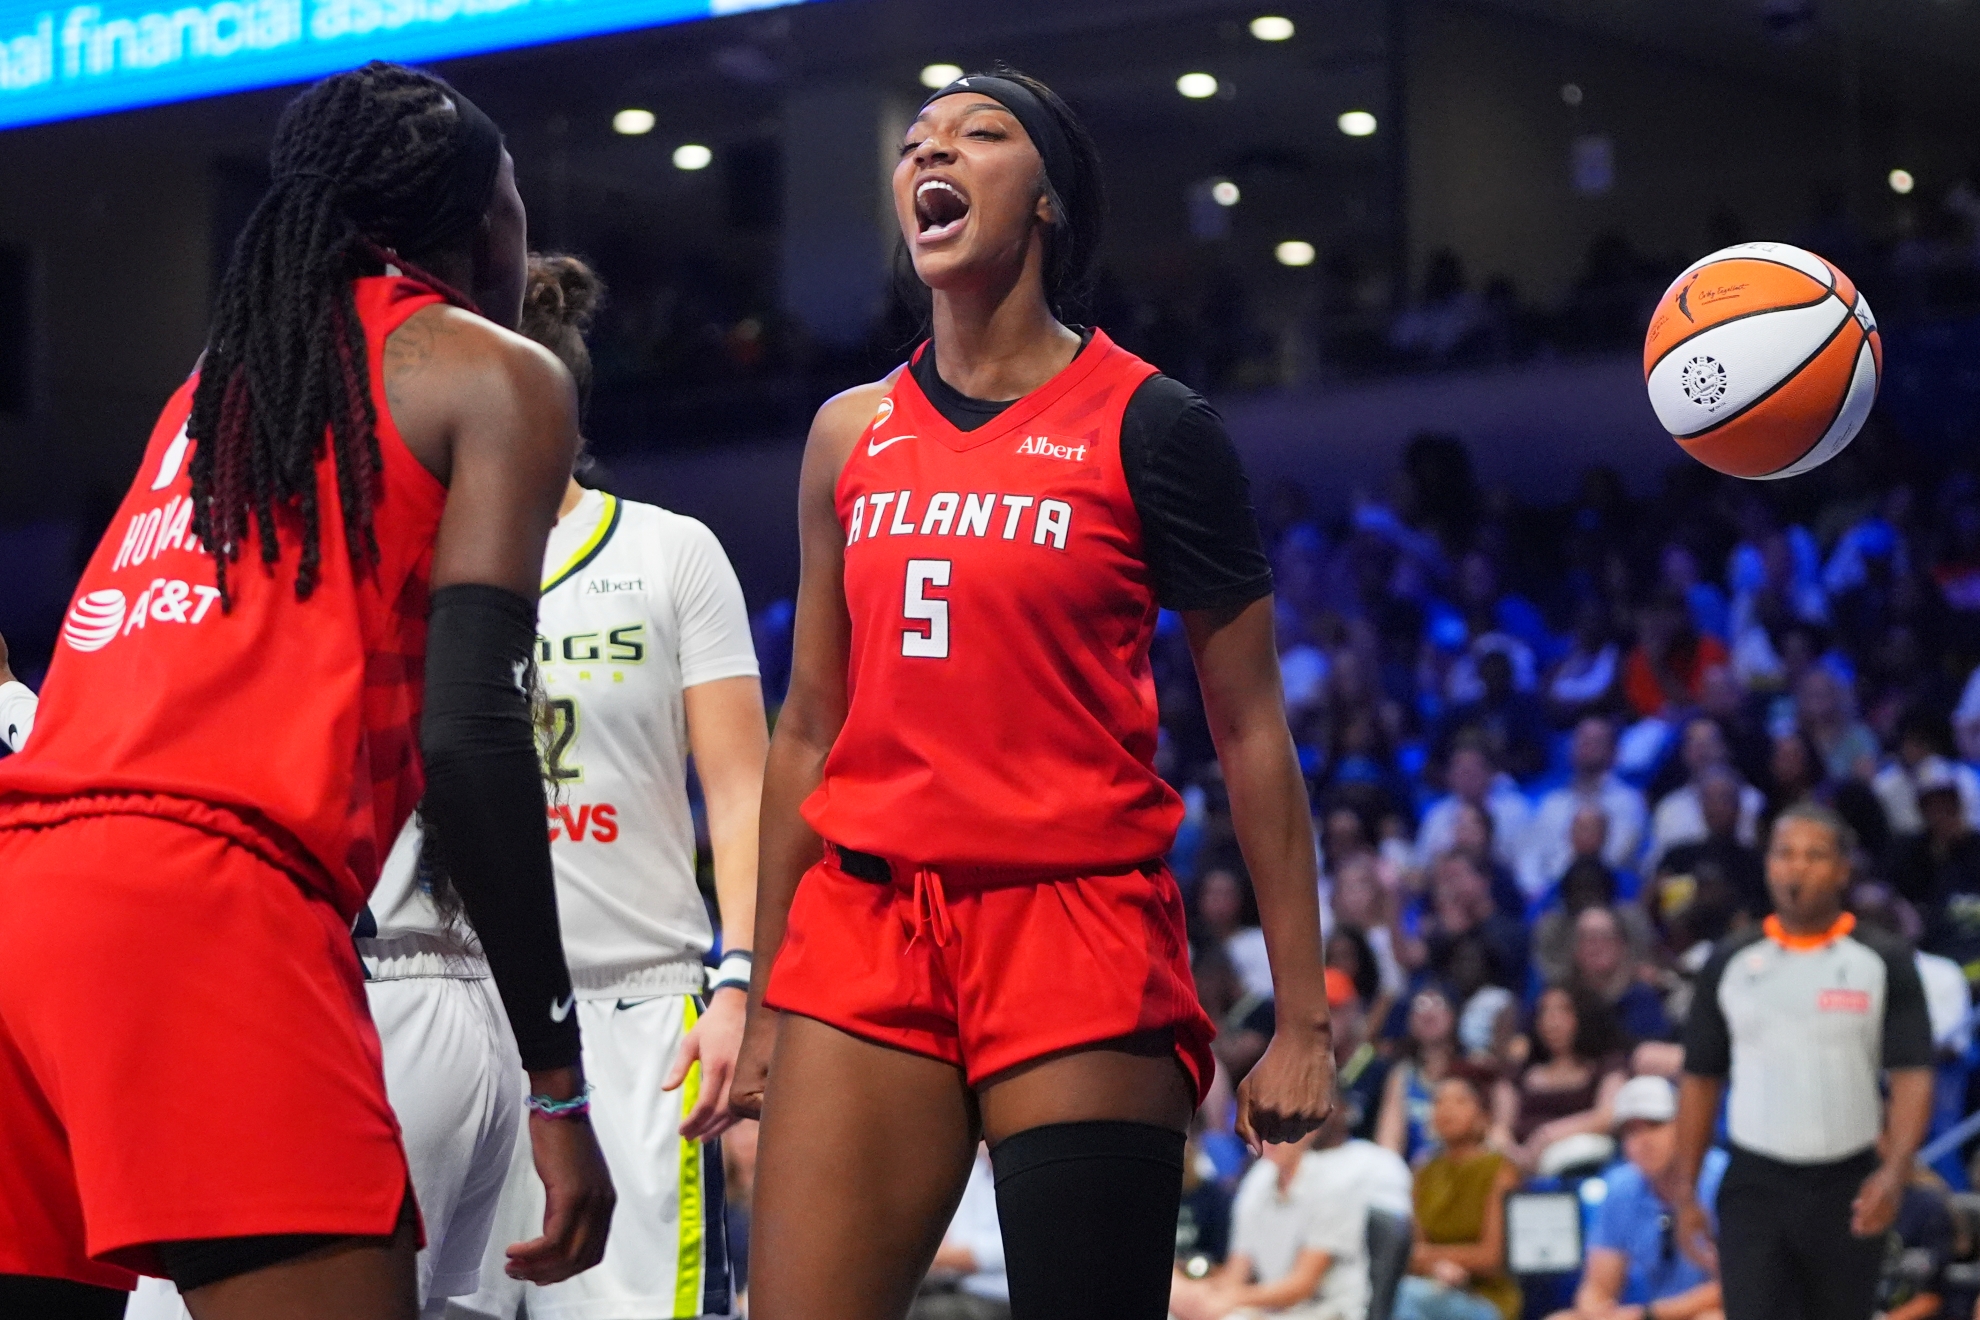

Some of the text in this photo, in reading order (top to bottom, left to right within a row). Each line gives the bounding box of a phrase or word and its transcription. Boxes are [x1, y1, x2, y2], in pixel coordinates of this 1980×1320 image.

[0, 16, 53, 89] al
[62, 2, 300, 78] financial
[1016, 434, 1087, 462] Albert
[846, 489, 1074, 550] ATLANTA
[586, 577, 645, 595] Albert
[901, 558, 953, 659] 5
